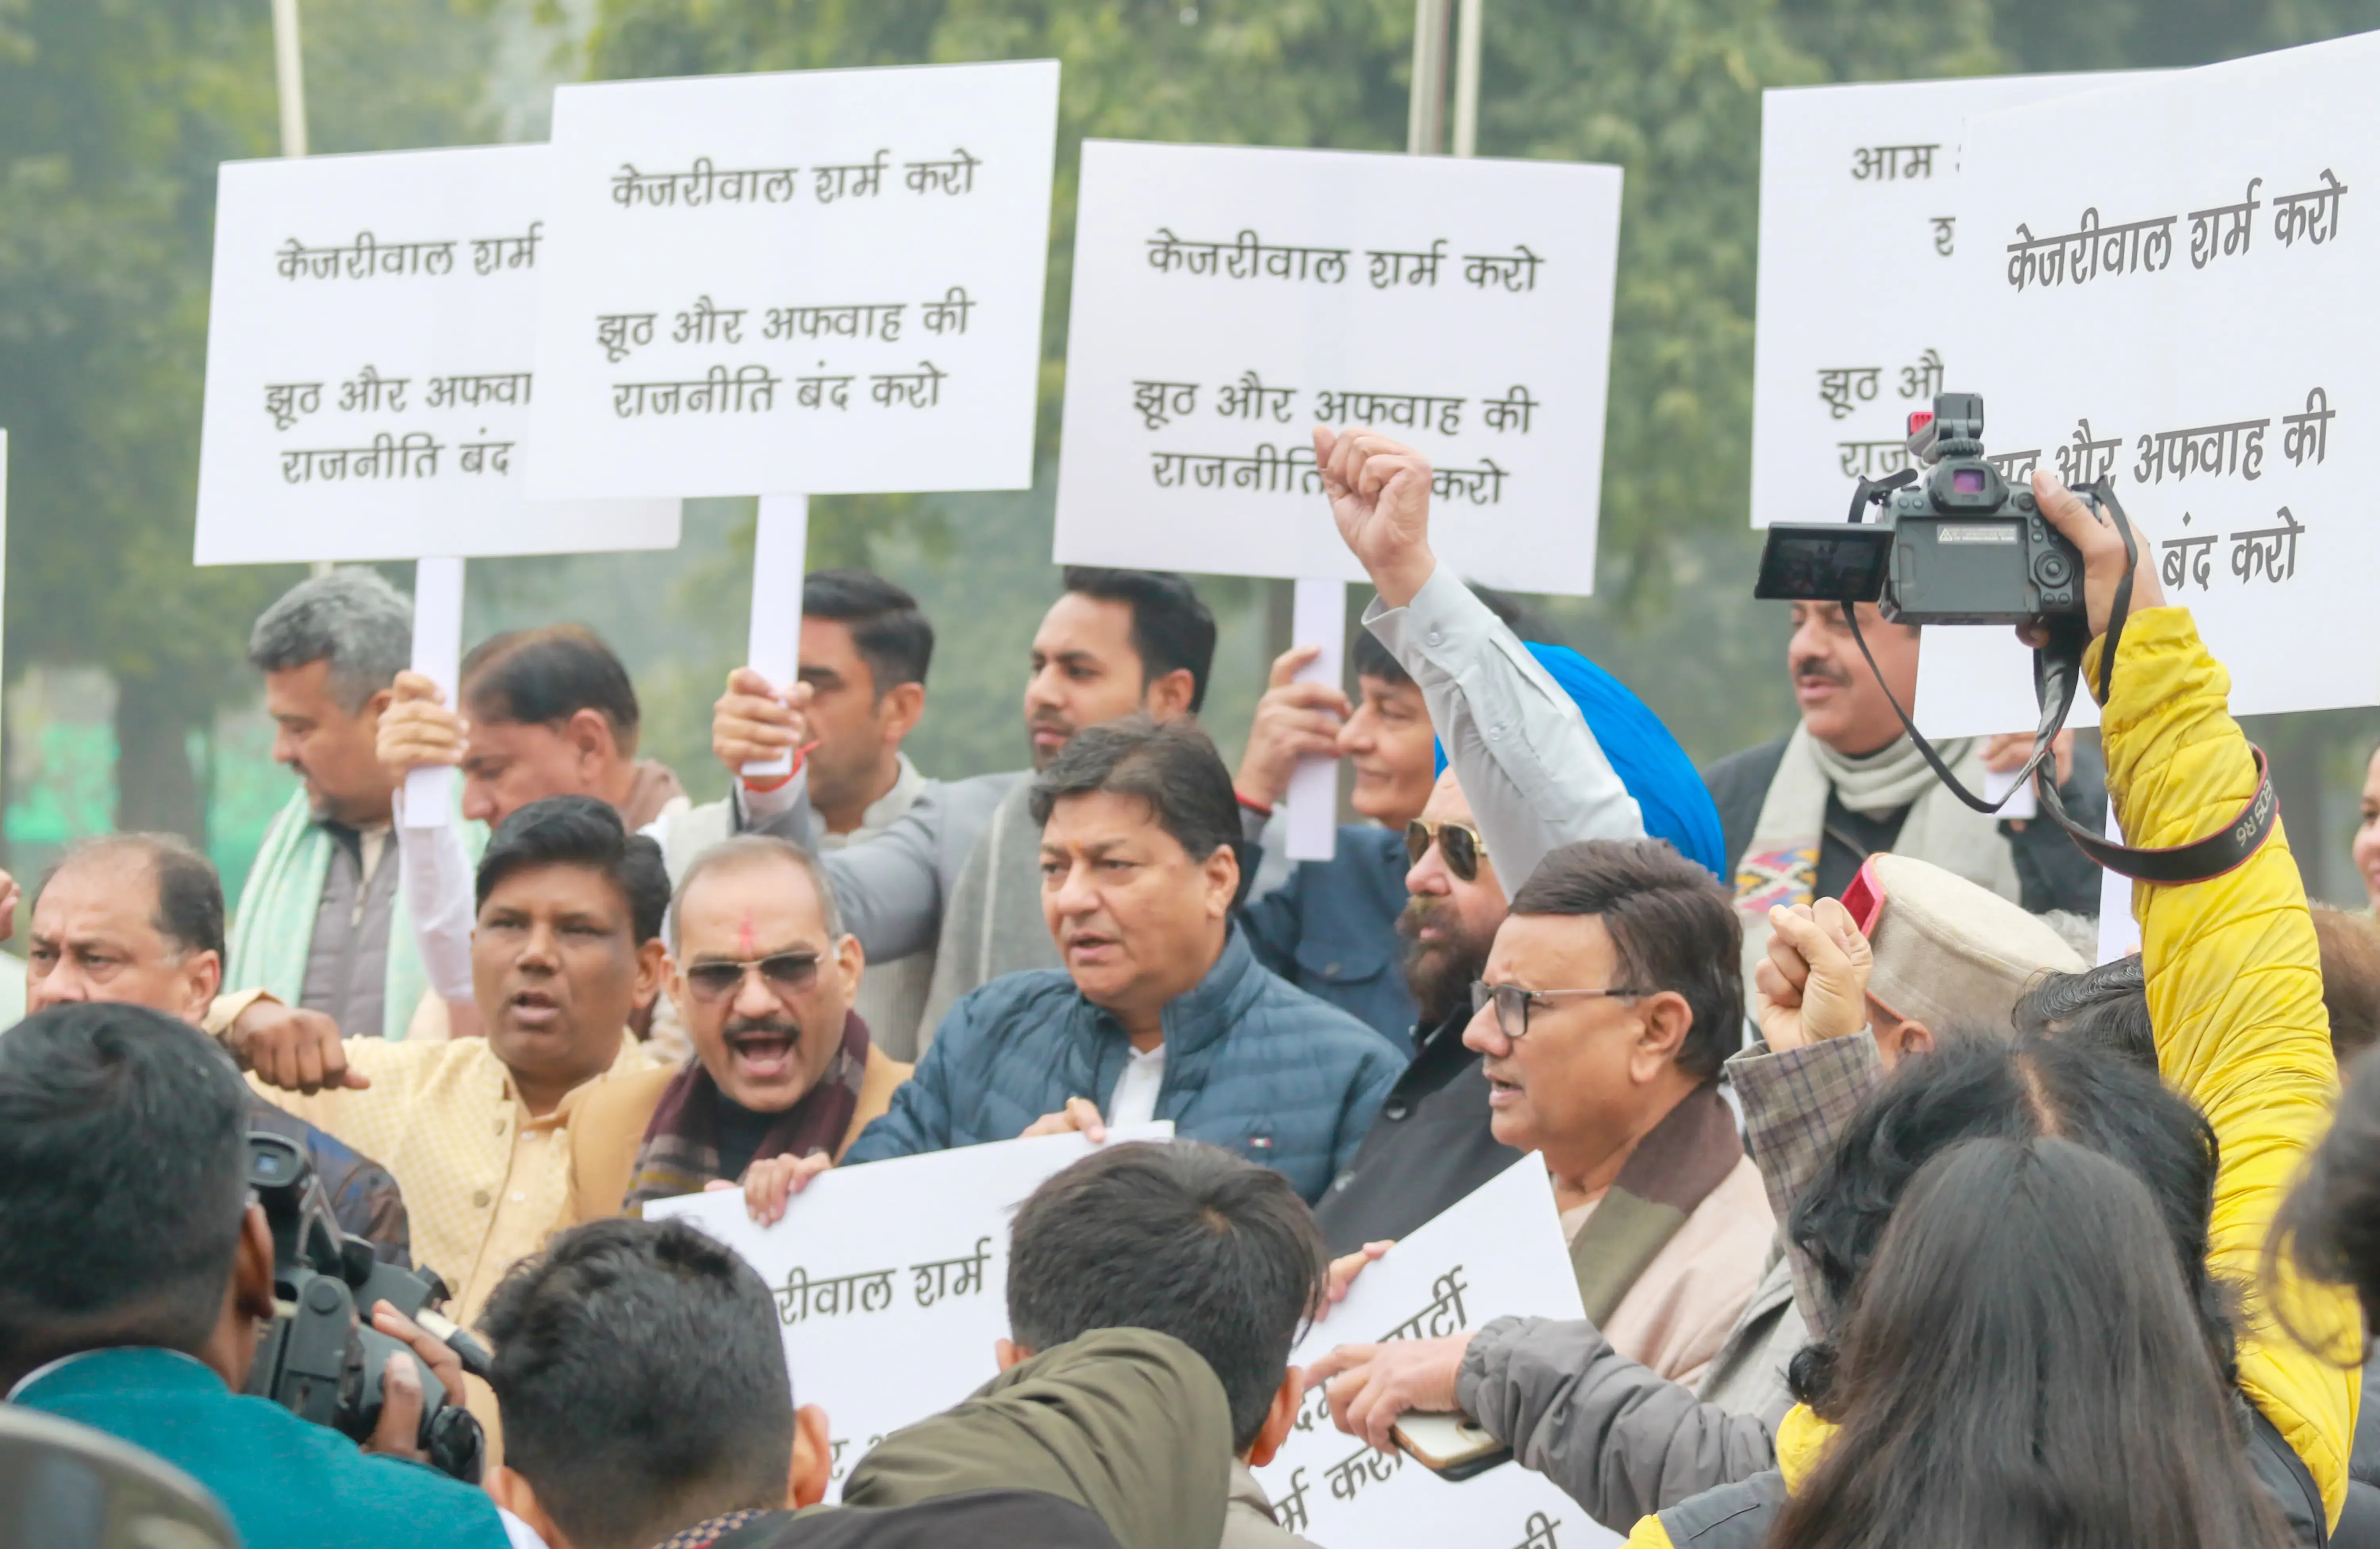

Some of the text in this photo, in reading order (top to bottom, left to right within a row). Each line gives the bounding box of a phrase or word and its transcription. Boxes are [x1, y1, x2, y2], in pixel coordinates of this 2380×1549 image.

[612, 148, 981, 207] केजरीवाल शर्म करो
[1852, 144, 1939, 179] आम
[277, 222, 542, 280] केजरीवाल शर्म
[1148, 228, 1544, 291] केजरीवाल शर्म करो
[2007, 208, 2177, 293] केजरीवाल
[2188, 178, 2262, 269] शर्म
[2273, 169, 2347, 248] करो
[597, 287, 975, 363] झूठ और अफवाह की
[265, 365, 532, 430] झूठ और अफवा
[612, 361, 947, 417] राजनीति बंद करो
[1134, 371, 1538, 435] झूठ और अफवाह की
[1818, 349, 1944, 419] झूठ औ
[281, 428, 514, 483] राजनीति बंद
[2134, 419, 2270, 485] अफवाह
[2283, 387, 2336, 467] की
[1433, 459, 1509, 504] करो
[2162, 506, 2305, 591] बंद करो
[2236, 779, 2272, 848] EOS R6
[773, 1237, 991, 1325] रीवाल शर्म
